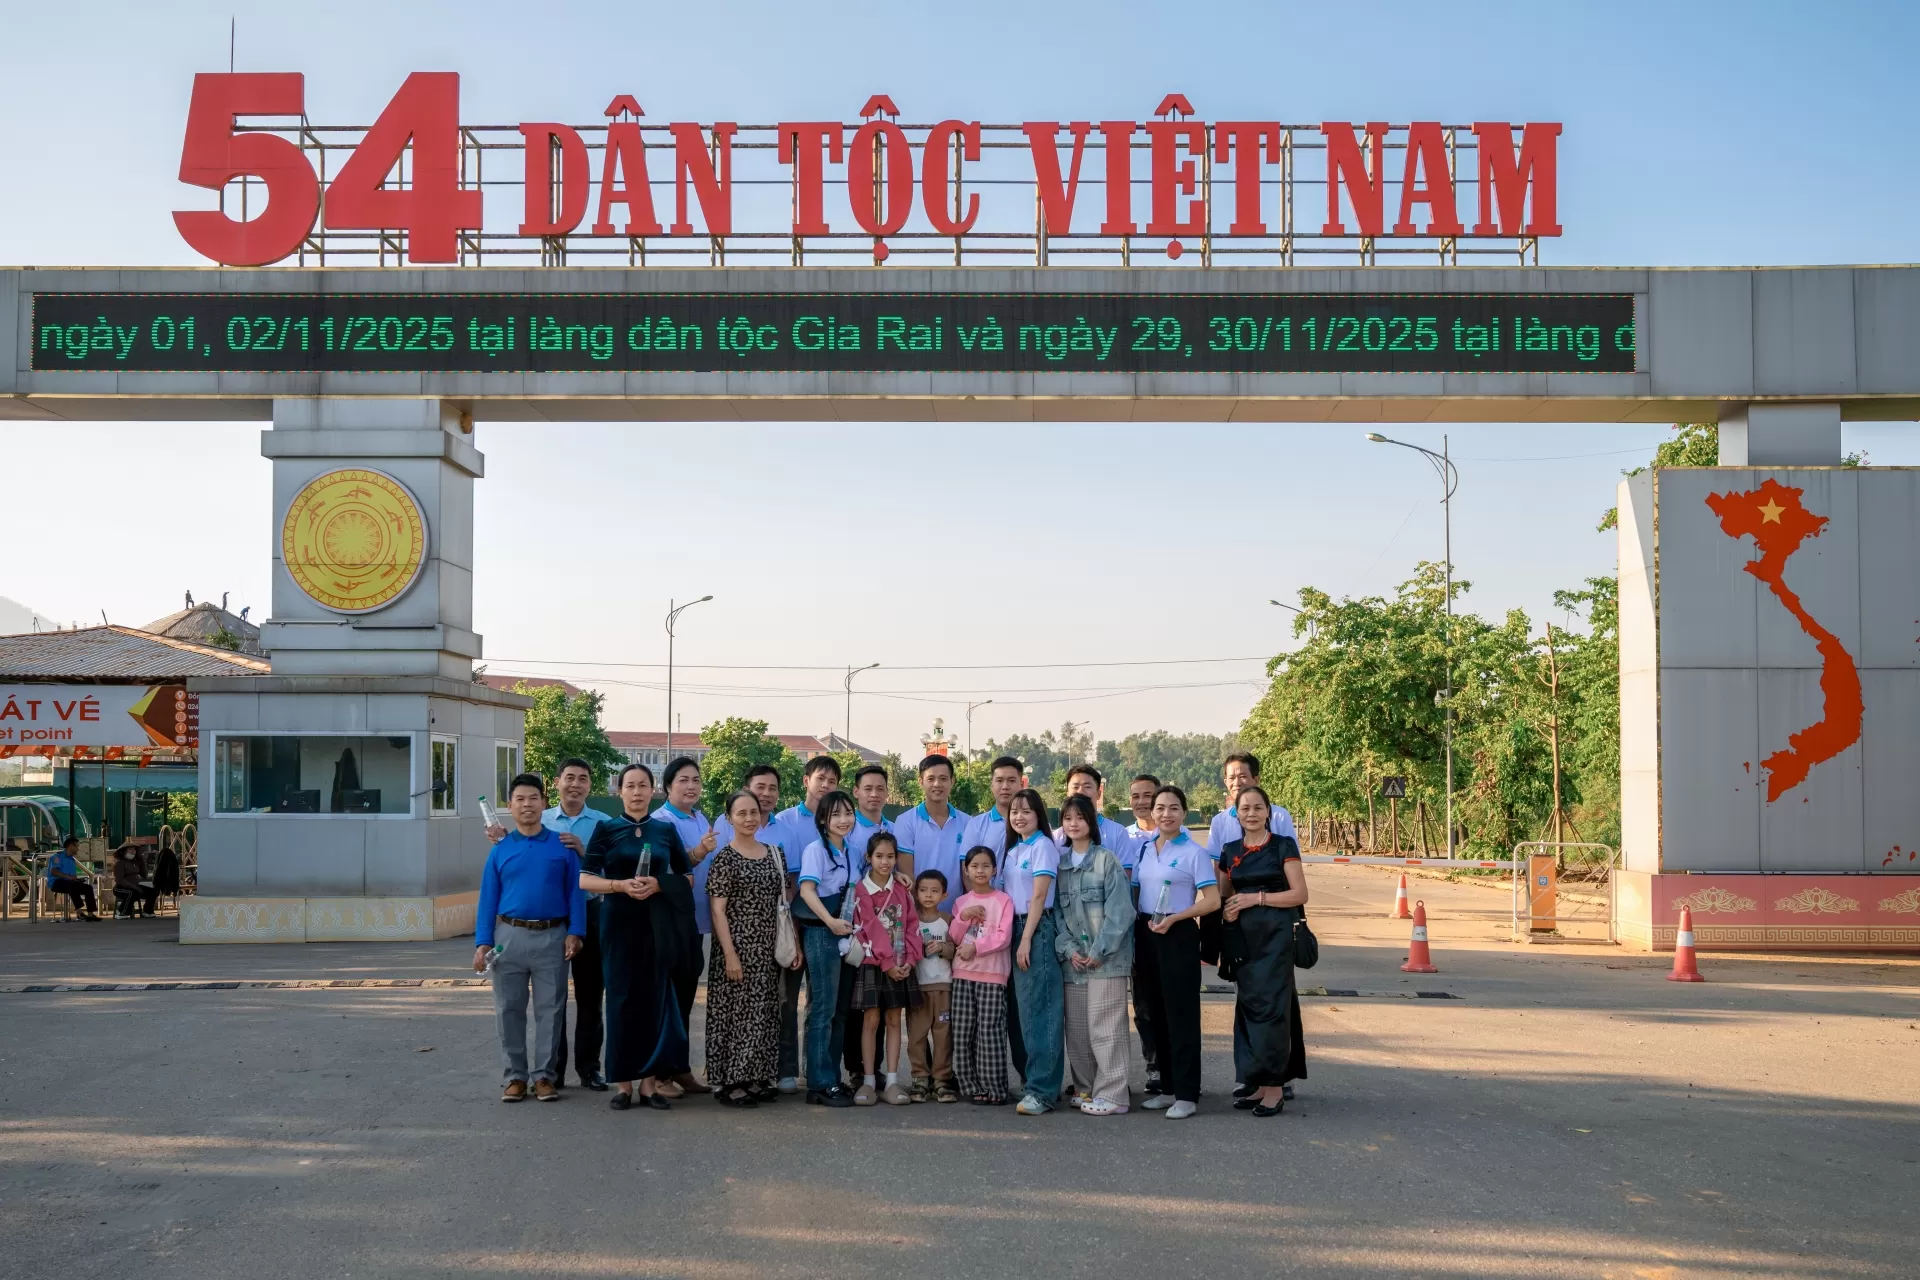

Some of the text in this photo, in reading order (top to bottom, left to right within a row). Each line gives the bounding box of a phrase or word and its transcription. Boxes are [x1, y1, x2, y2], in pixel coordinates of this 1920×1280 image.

[172, 72, 1563, 266] 54 DÂN TỘC VIỆT NAM
[41, 317, 138, 359] ngày
[151, 316, 211, 357] 01,
[228, 316, 455, 351] 02/11/2025
[467, 316, 515, 357] tại
[529, 316, 614, 360] làng
[627, 316, 703, 351] dân
[716, 316, 779, 357] tộc
[791, 316, 861, 350] Gia
[877, 316, 942, 351] Rai
[956, 316, 1004, 351] và
[1019, 316, 1119, 361] ngày
[1131, 316, 1193, 358] 29,
[1208, 317, 1439, 351] 30/11/2025
[1451, 317, 1500, 357] tại
[1514, 317, 1600, 361] làng
[52, 694, 100, 721] VÉ
[20, 727, 73, 742] point
